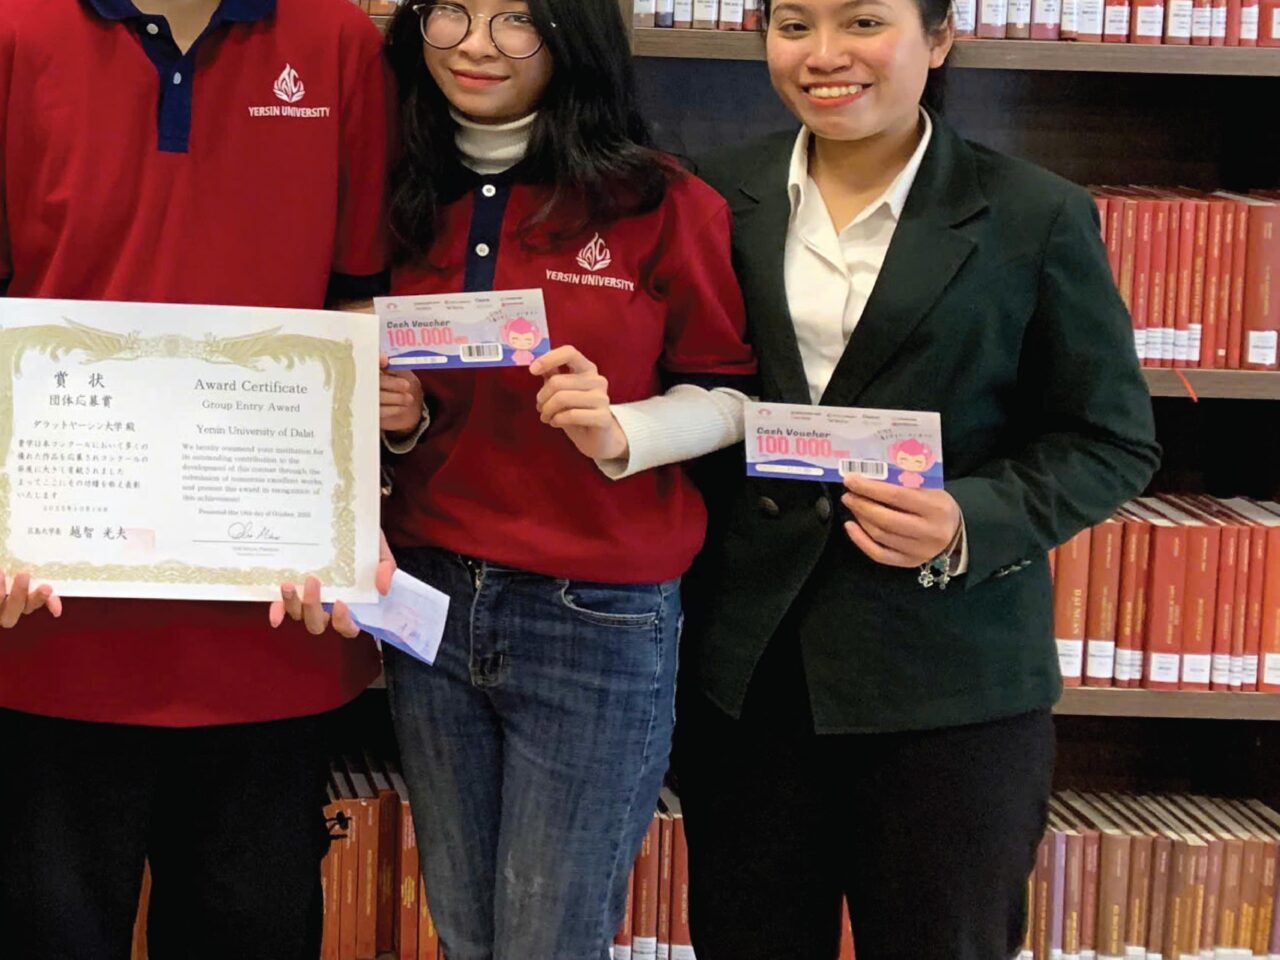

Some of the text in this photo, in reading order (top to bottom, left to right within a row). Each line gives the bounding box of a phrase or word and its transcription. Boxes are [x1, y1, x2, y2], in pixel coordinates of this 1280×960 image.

[248, 106, 330, 118] YERSIN UNIVERSITY
[546, 269, 635, 292] YERSIN UNIVERSITY
[387, 319, 451, 329] Cash Voucher
[194, 378, 308, 394] Award Certificate
[201, 399, 301, 413] Group Entry Award
[228, 426, 276, 438] University
[278, 427, 287, 437] of
[290, 427, 315, 438] Dalat
[756, 426, 831, 439] Cash Voucher
